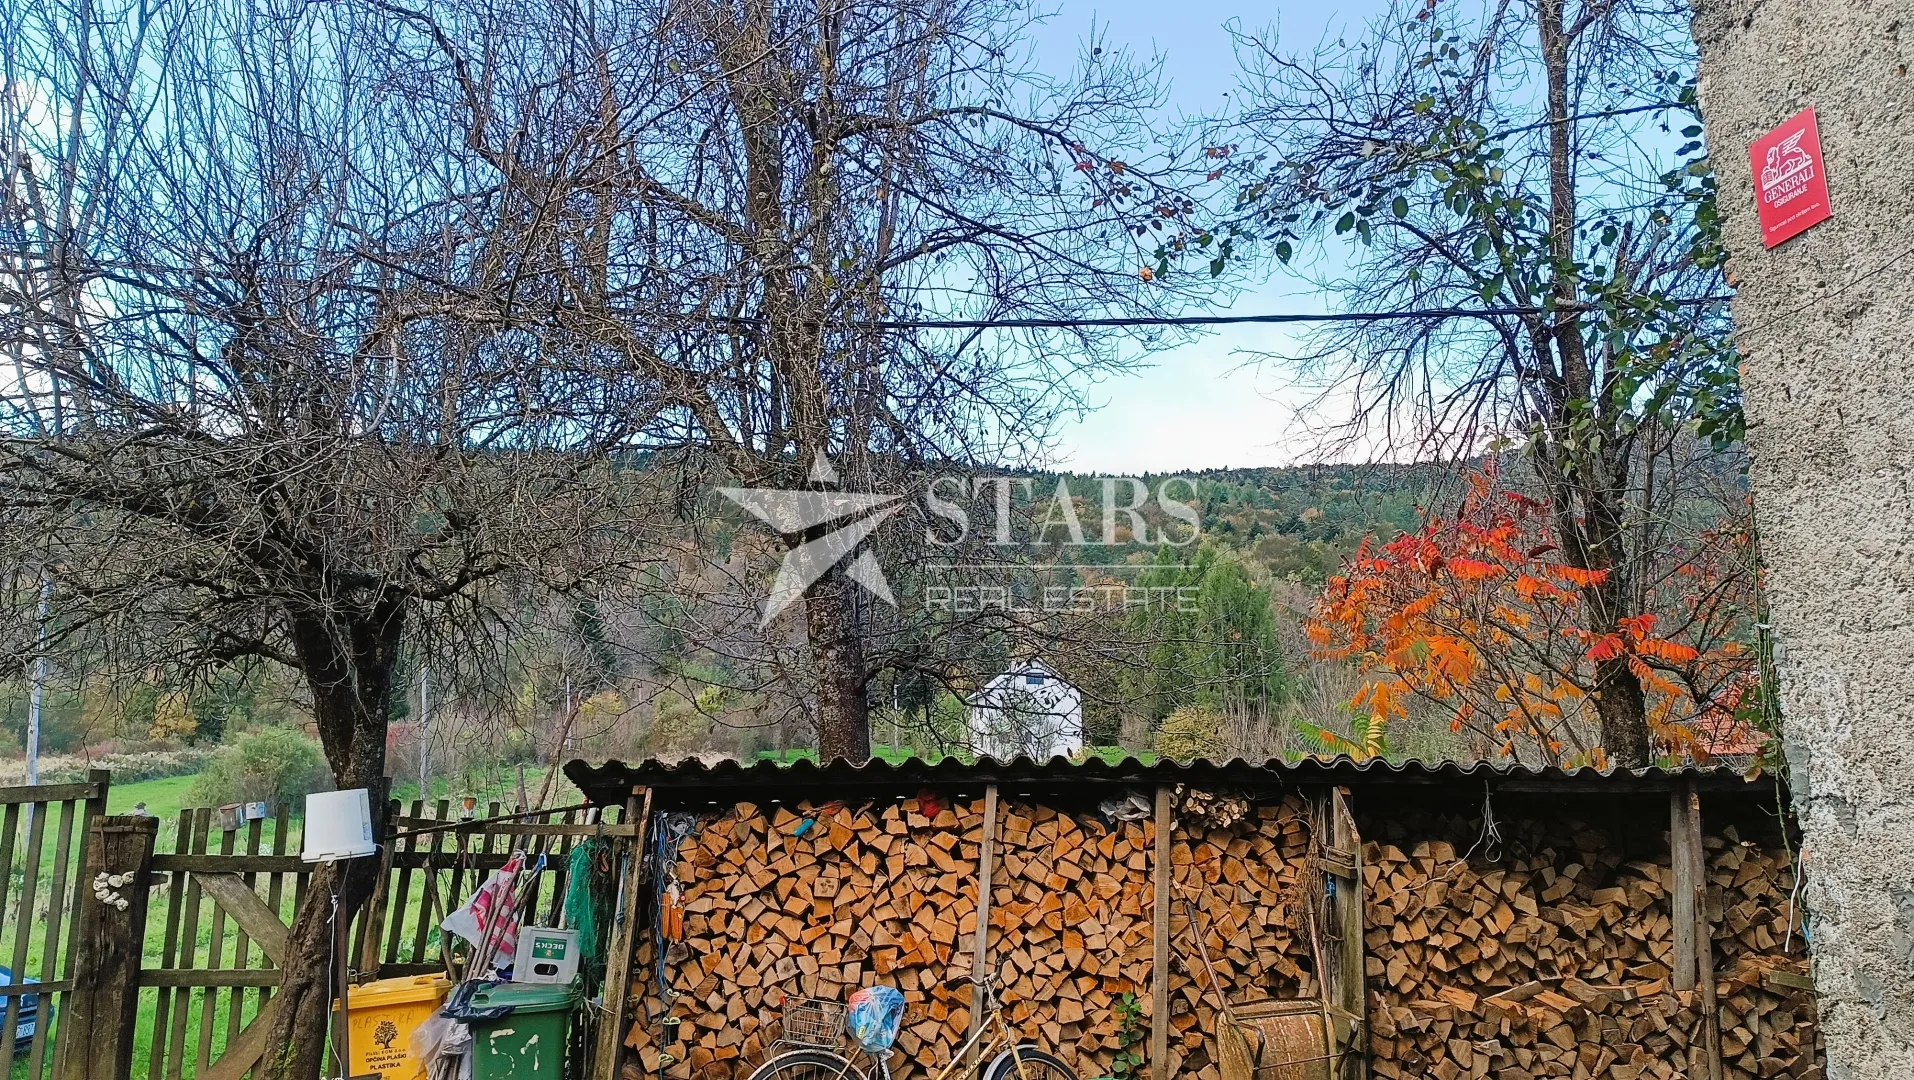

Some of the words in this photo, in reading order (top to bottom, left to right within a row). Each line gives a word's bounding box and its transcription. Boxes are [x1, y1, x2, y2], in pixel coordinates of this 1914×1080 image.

[1764, 165, 1815, 204] GENERALI
[1774, 184, 1808, 209] OSIGURANJE
[370, 1062, 401, 1070] PLASTIKA
